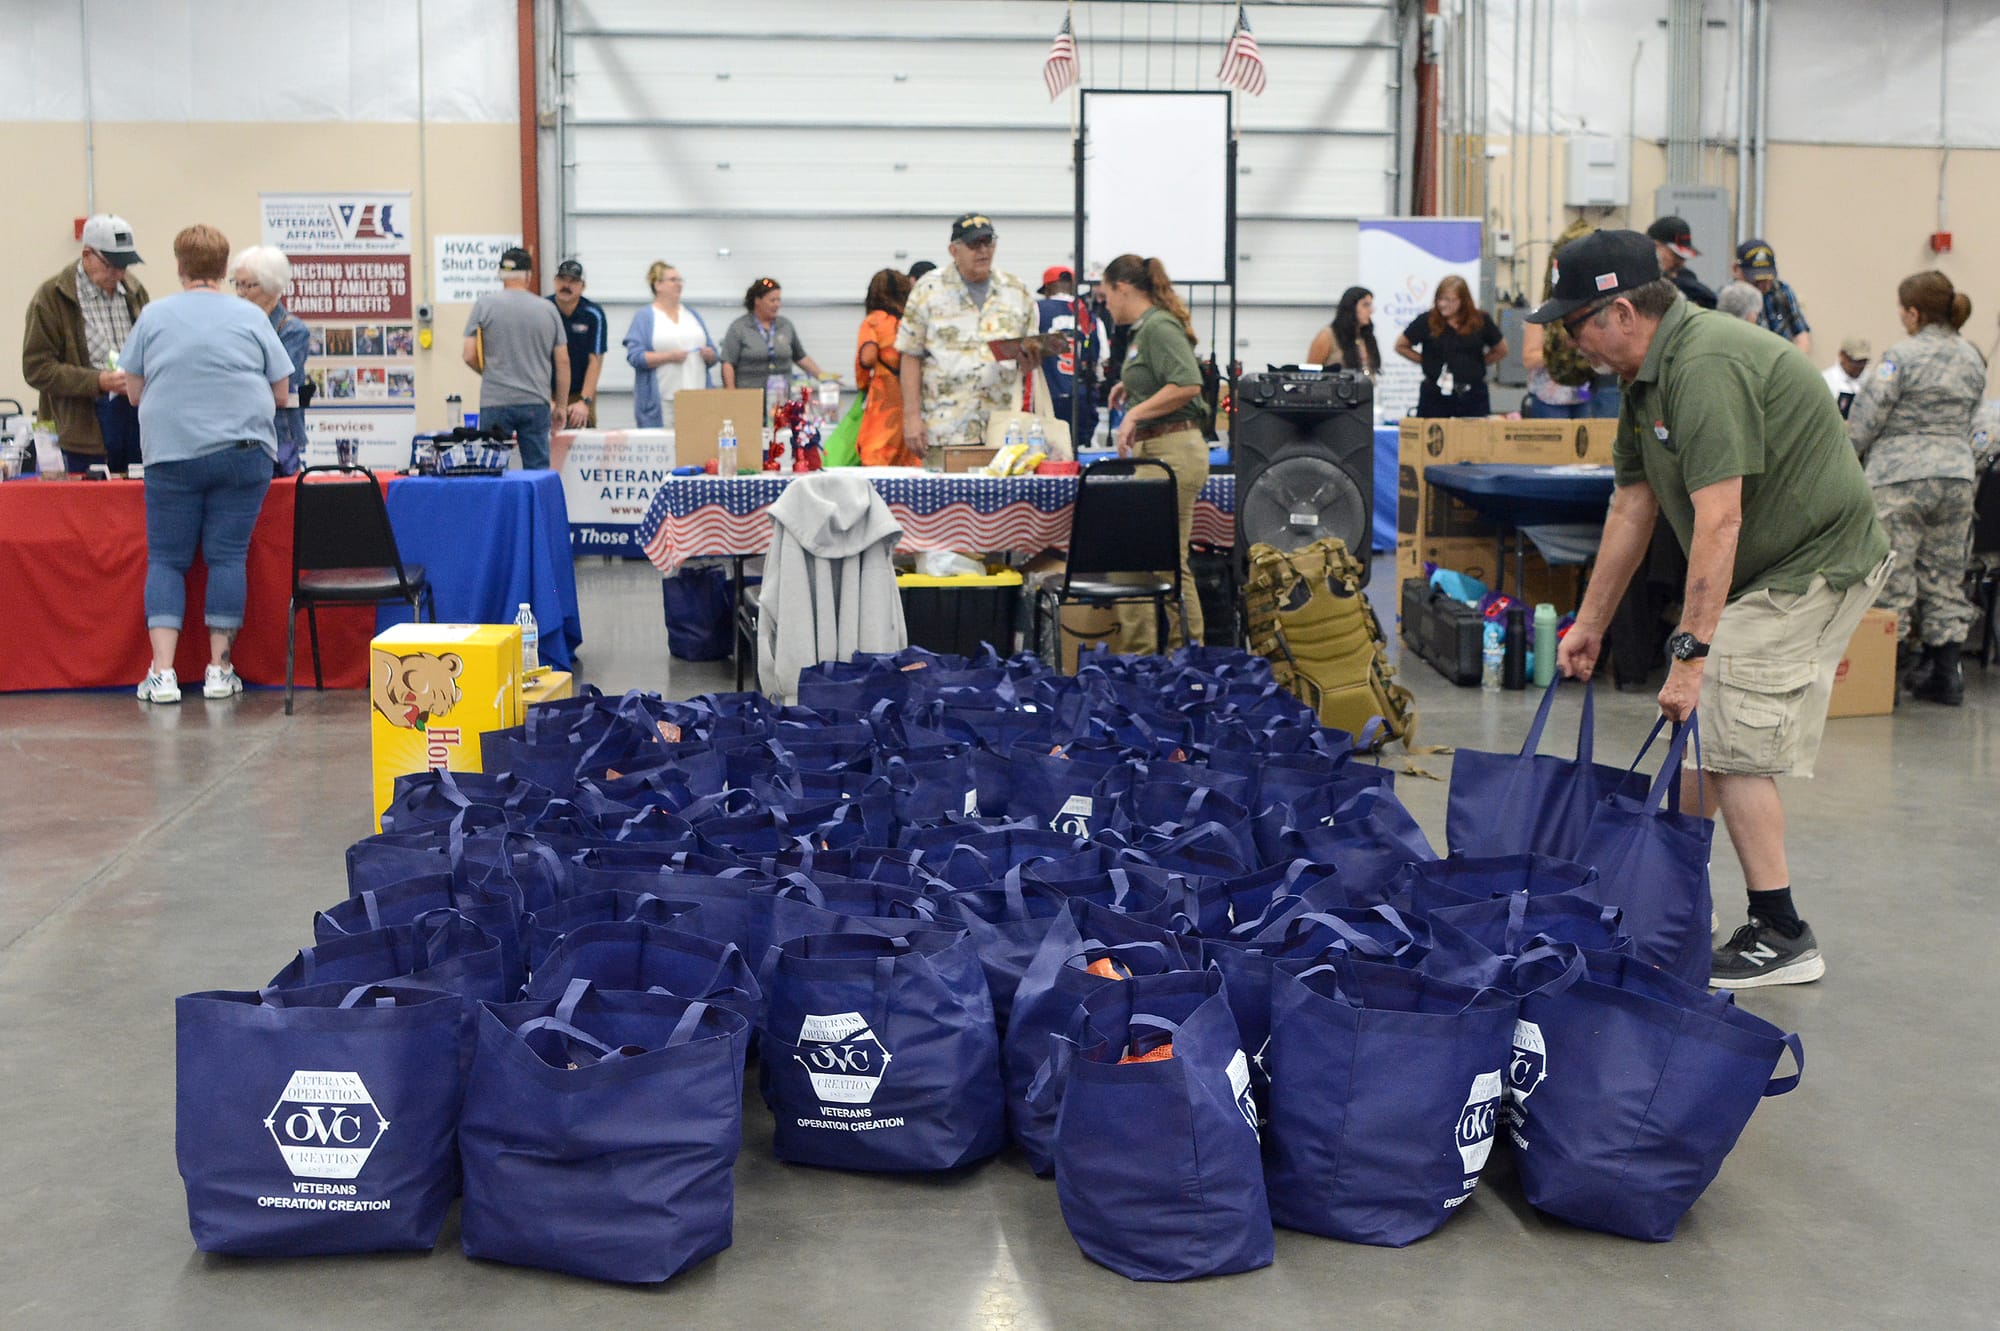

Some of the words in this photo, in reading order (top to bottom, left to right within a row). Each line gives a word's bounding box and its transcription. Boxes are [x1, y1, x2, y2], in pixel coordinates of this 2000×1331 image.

[268, 218, 332, 228] VETERANS
[286, 230, 336, 240] AFFAIRS
[445, 242, 484, 254] HVAC
[442, 258, 473, 270] Shut
[478, 258, 499, 270] Do
[345, 263, 406, 279] VETERANS
[298, 279, 332, 295] THEIR
[334, 279, 388, 295] FAMILIES
[391, 279, 406, 295] TO
[454, 290, 473, 299] are
[286, 296, 332, 312] EARNED
[335, 296, 391, 312] BENEFITS
[319, 421, 375, 432] Services
[568, 444, 632, 453] WASHINGTON
[638, 444, 667, 453] STATE
[570, 454, 650, 463] DEPARTMENT
[657, 454, 670, 463] OF
[600, 487, 658, 500] AFFA
[580, 528, 630, 545] Those
[428, 728, 460, 773] Hor
[809, 1044, 870, 1073] OVC
[296, 1075, 357, 1086] VETERANS
[817, 1078, 871, 1091] CREATION
[288, 1087, 362, 1100] OPERATION
[820, 1106, 872, 1119] VETERANS
[285, 1105, 361, 1145] OVC
[797, 1118, 850, 1132] OPERATION
[850, 1116, 905, 1132] CREATION
[290, 1152, 361, 1165] CREATION
[292, 1182, 358, 1196] VETERANS
[257, 1196, 327, 1211] OPERATION
[328, 1199, 392, 1212] CREATION
